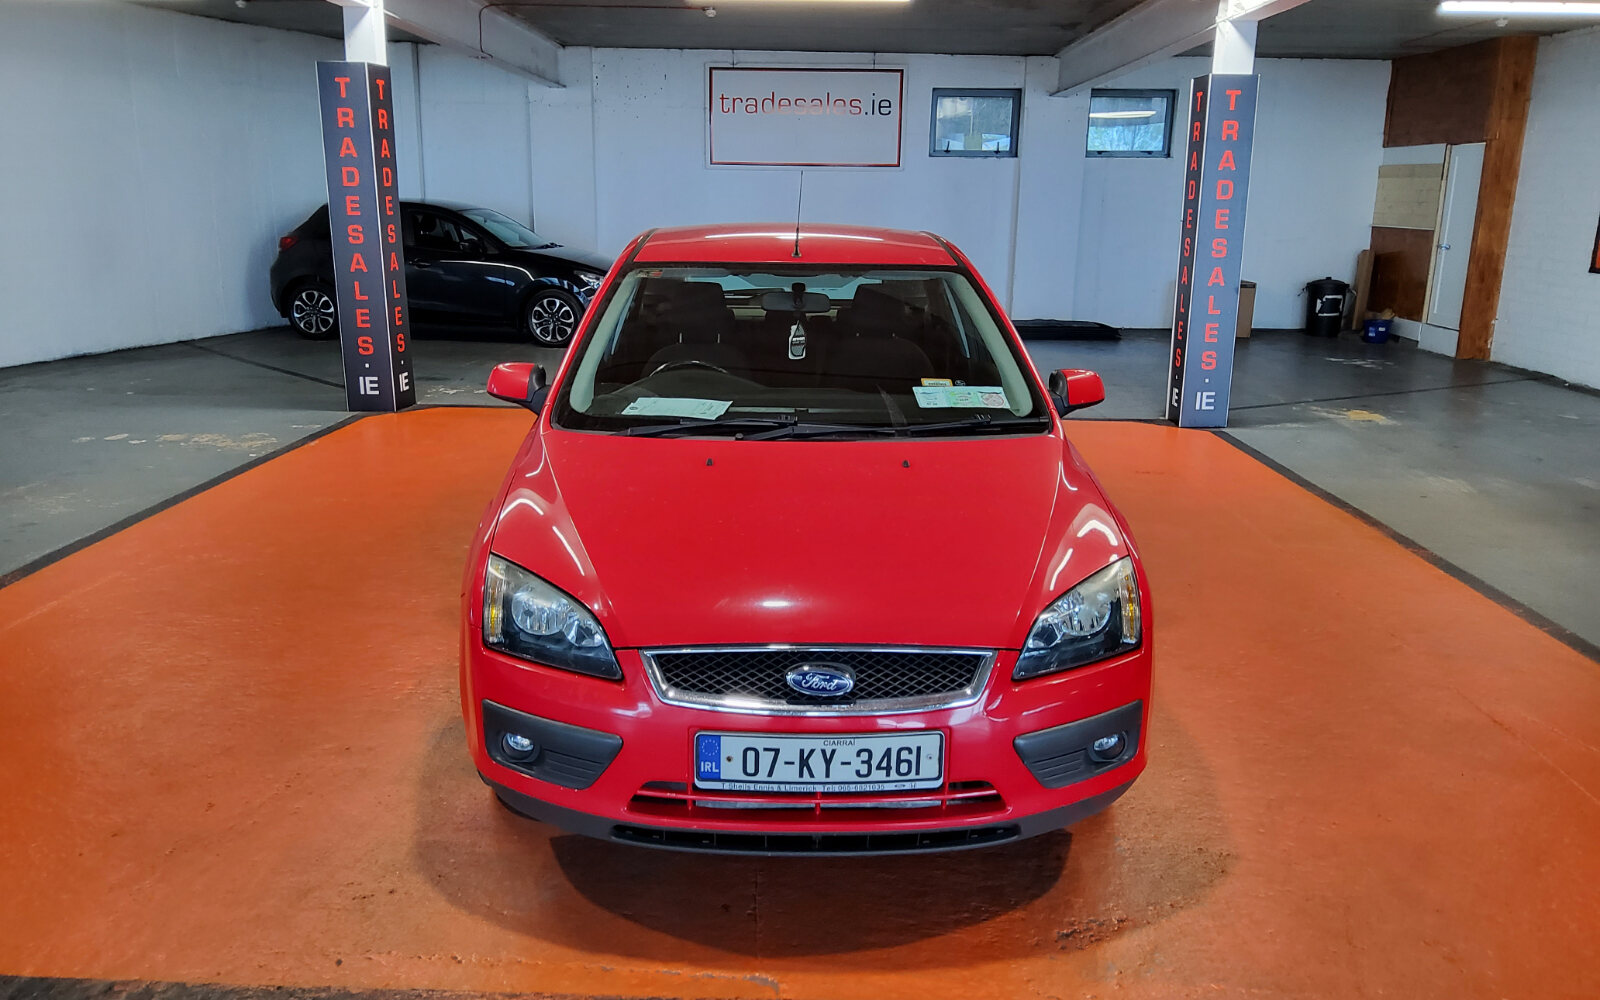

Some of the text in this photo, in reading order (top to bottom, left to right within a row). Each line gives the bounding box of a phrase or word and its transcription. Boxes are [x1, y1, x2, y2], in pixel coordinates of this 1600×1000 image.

[719, 91, 892, 116] tradesales.ie
[802, 673, 837, 691] Ford
[701, 761, 720, 773] IRL
[742, 745, 922, 779] 07-KY-3461
